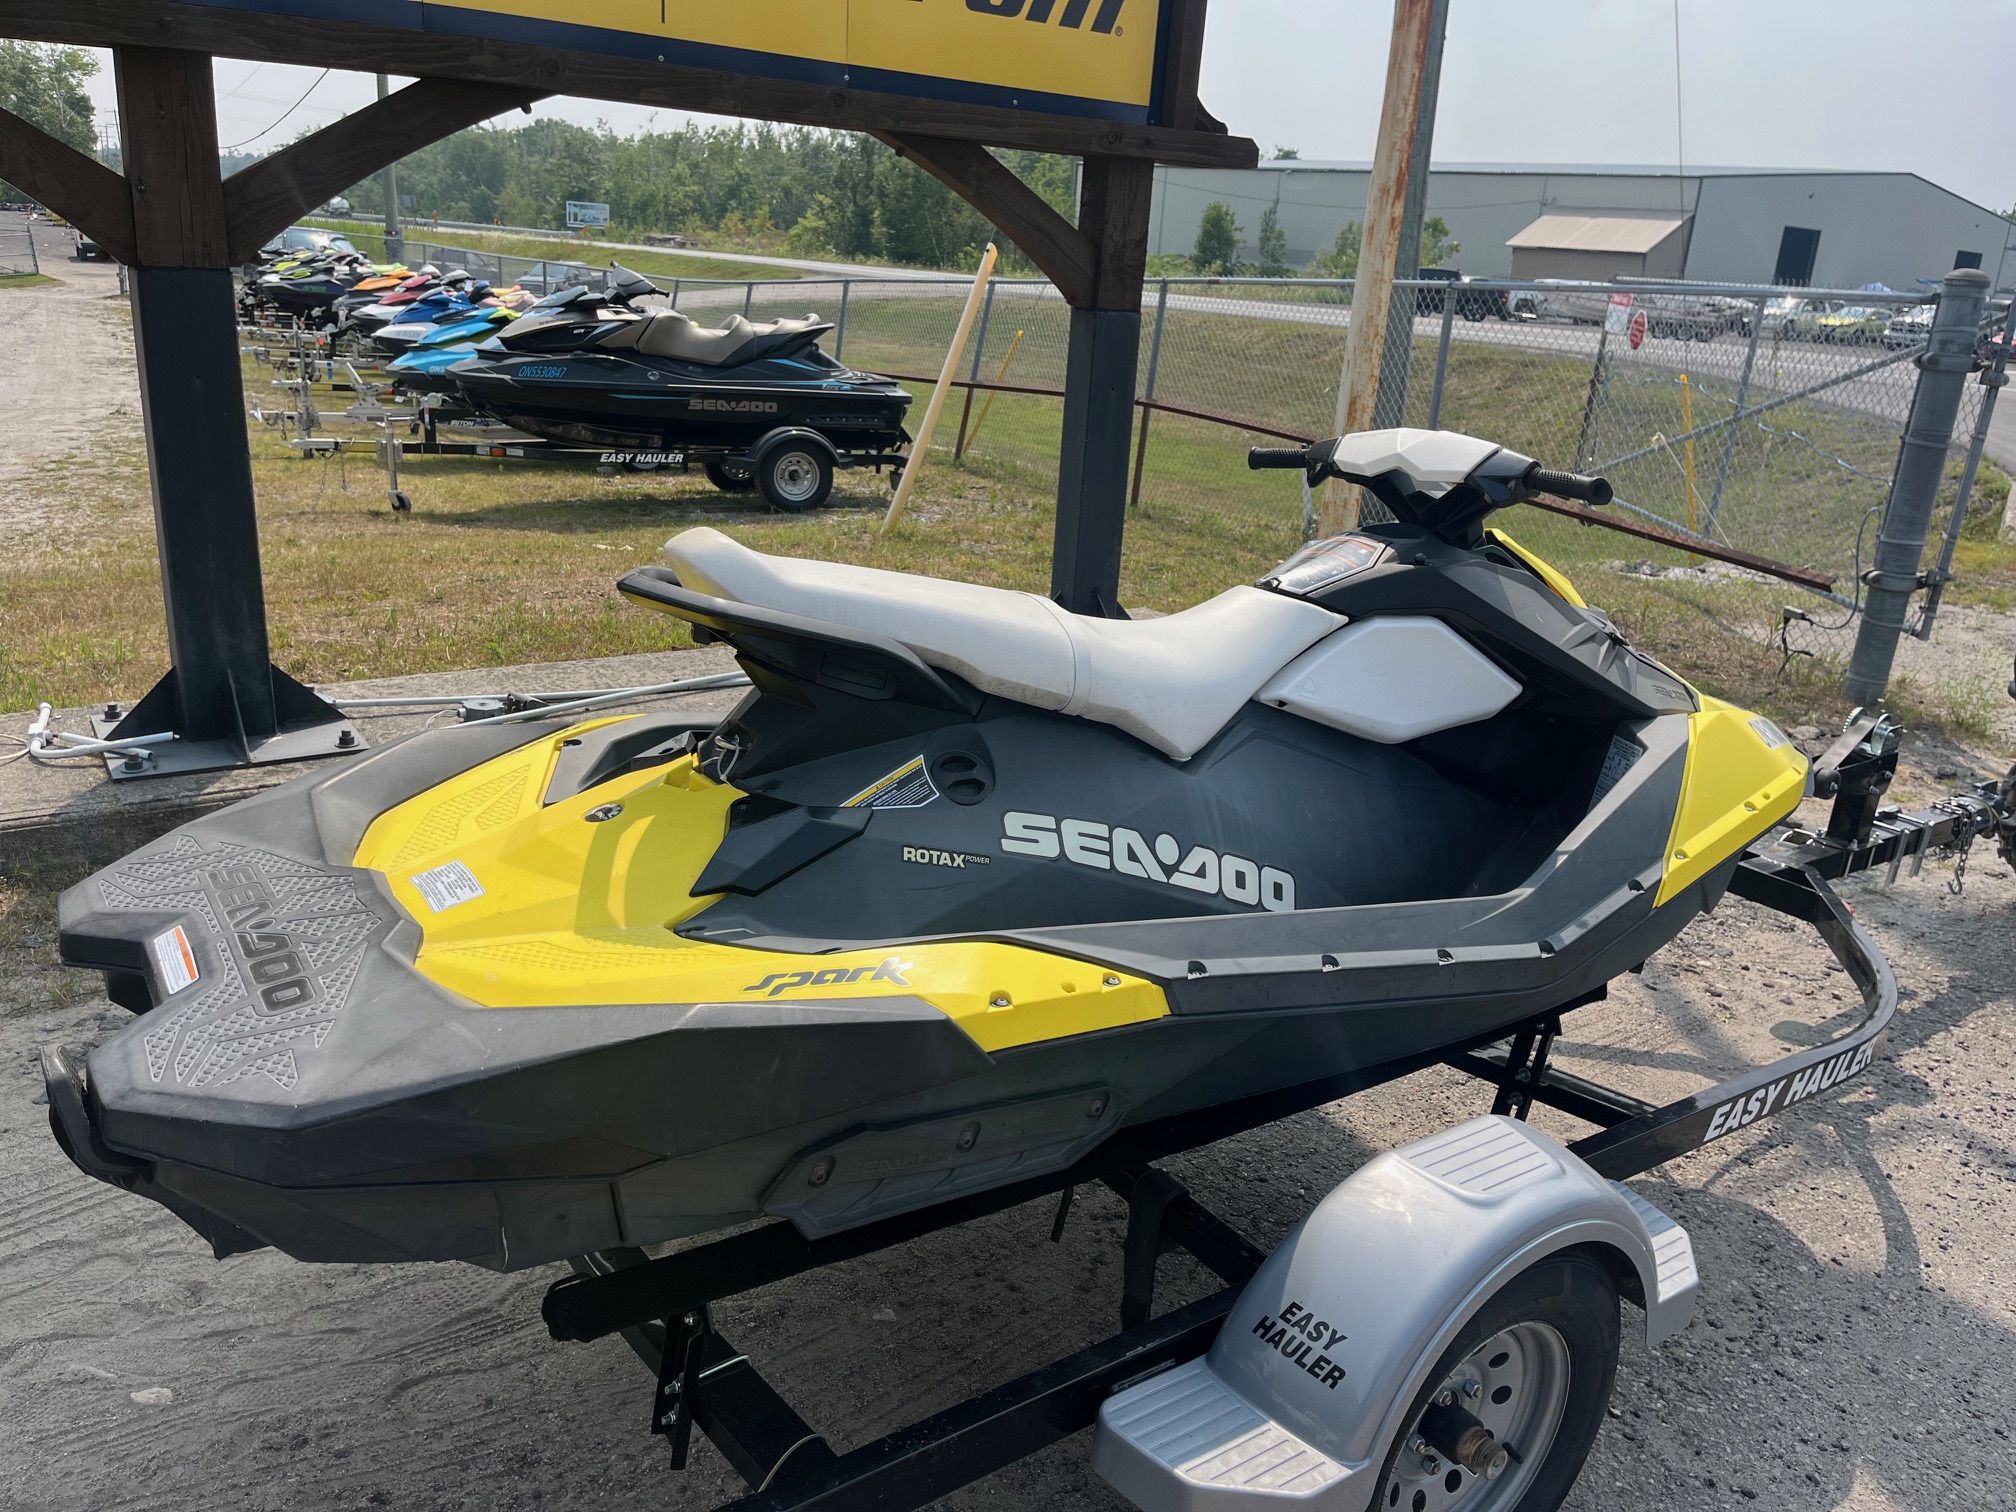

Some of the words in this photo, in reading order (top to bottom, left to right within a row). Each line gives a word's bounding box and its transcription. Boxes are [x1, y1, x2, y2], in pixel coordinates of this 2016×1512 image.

[518, 365, 567, 378] ON5530847
[600, 453, 634, 463] EASY
[635, 453, 684, 463] HAULER
[903, 846, 966, 868] ROTAX
[965, 855, 990, 865] POWER
[1703, 1079, 1788, 1142] EASY
[1782, 1034, 1879, 1107] HAULER
[1279, 1301, 1348, 1351] EASY
[1252, 1315, 1346, 1390] HAULER
